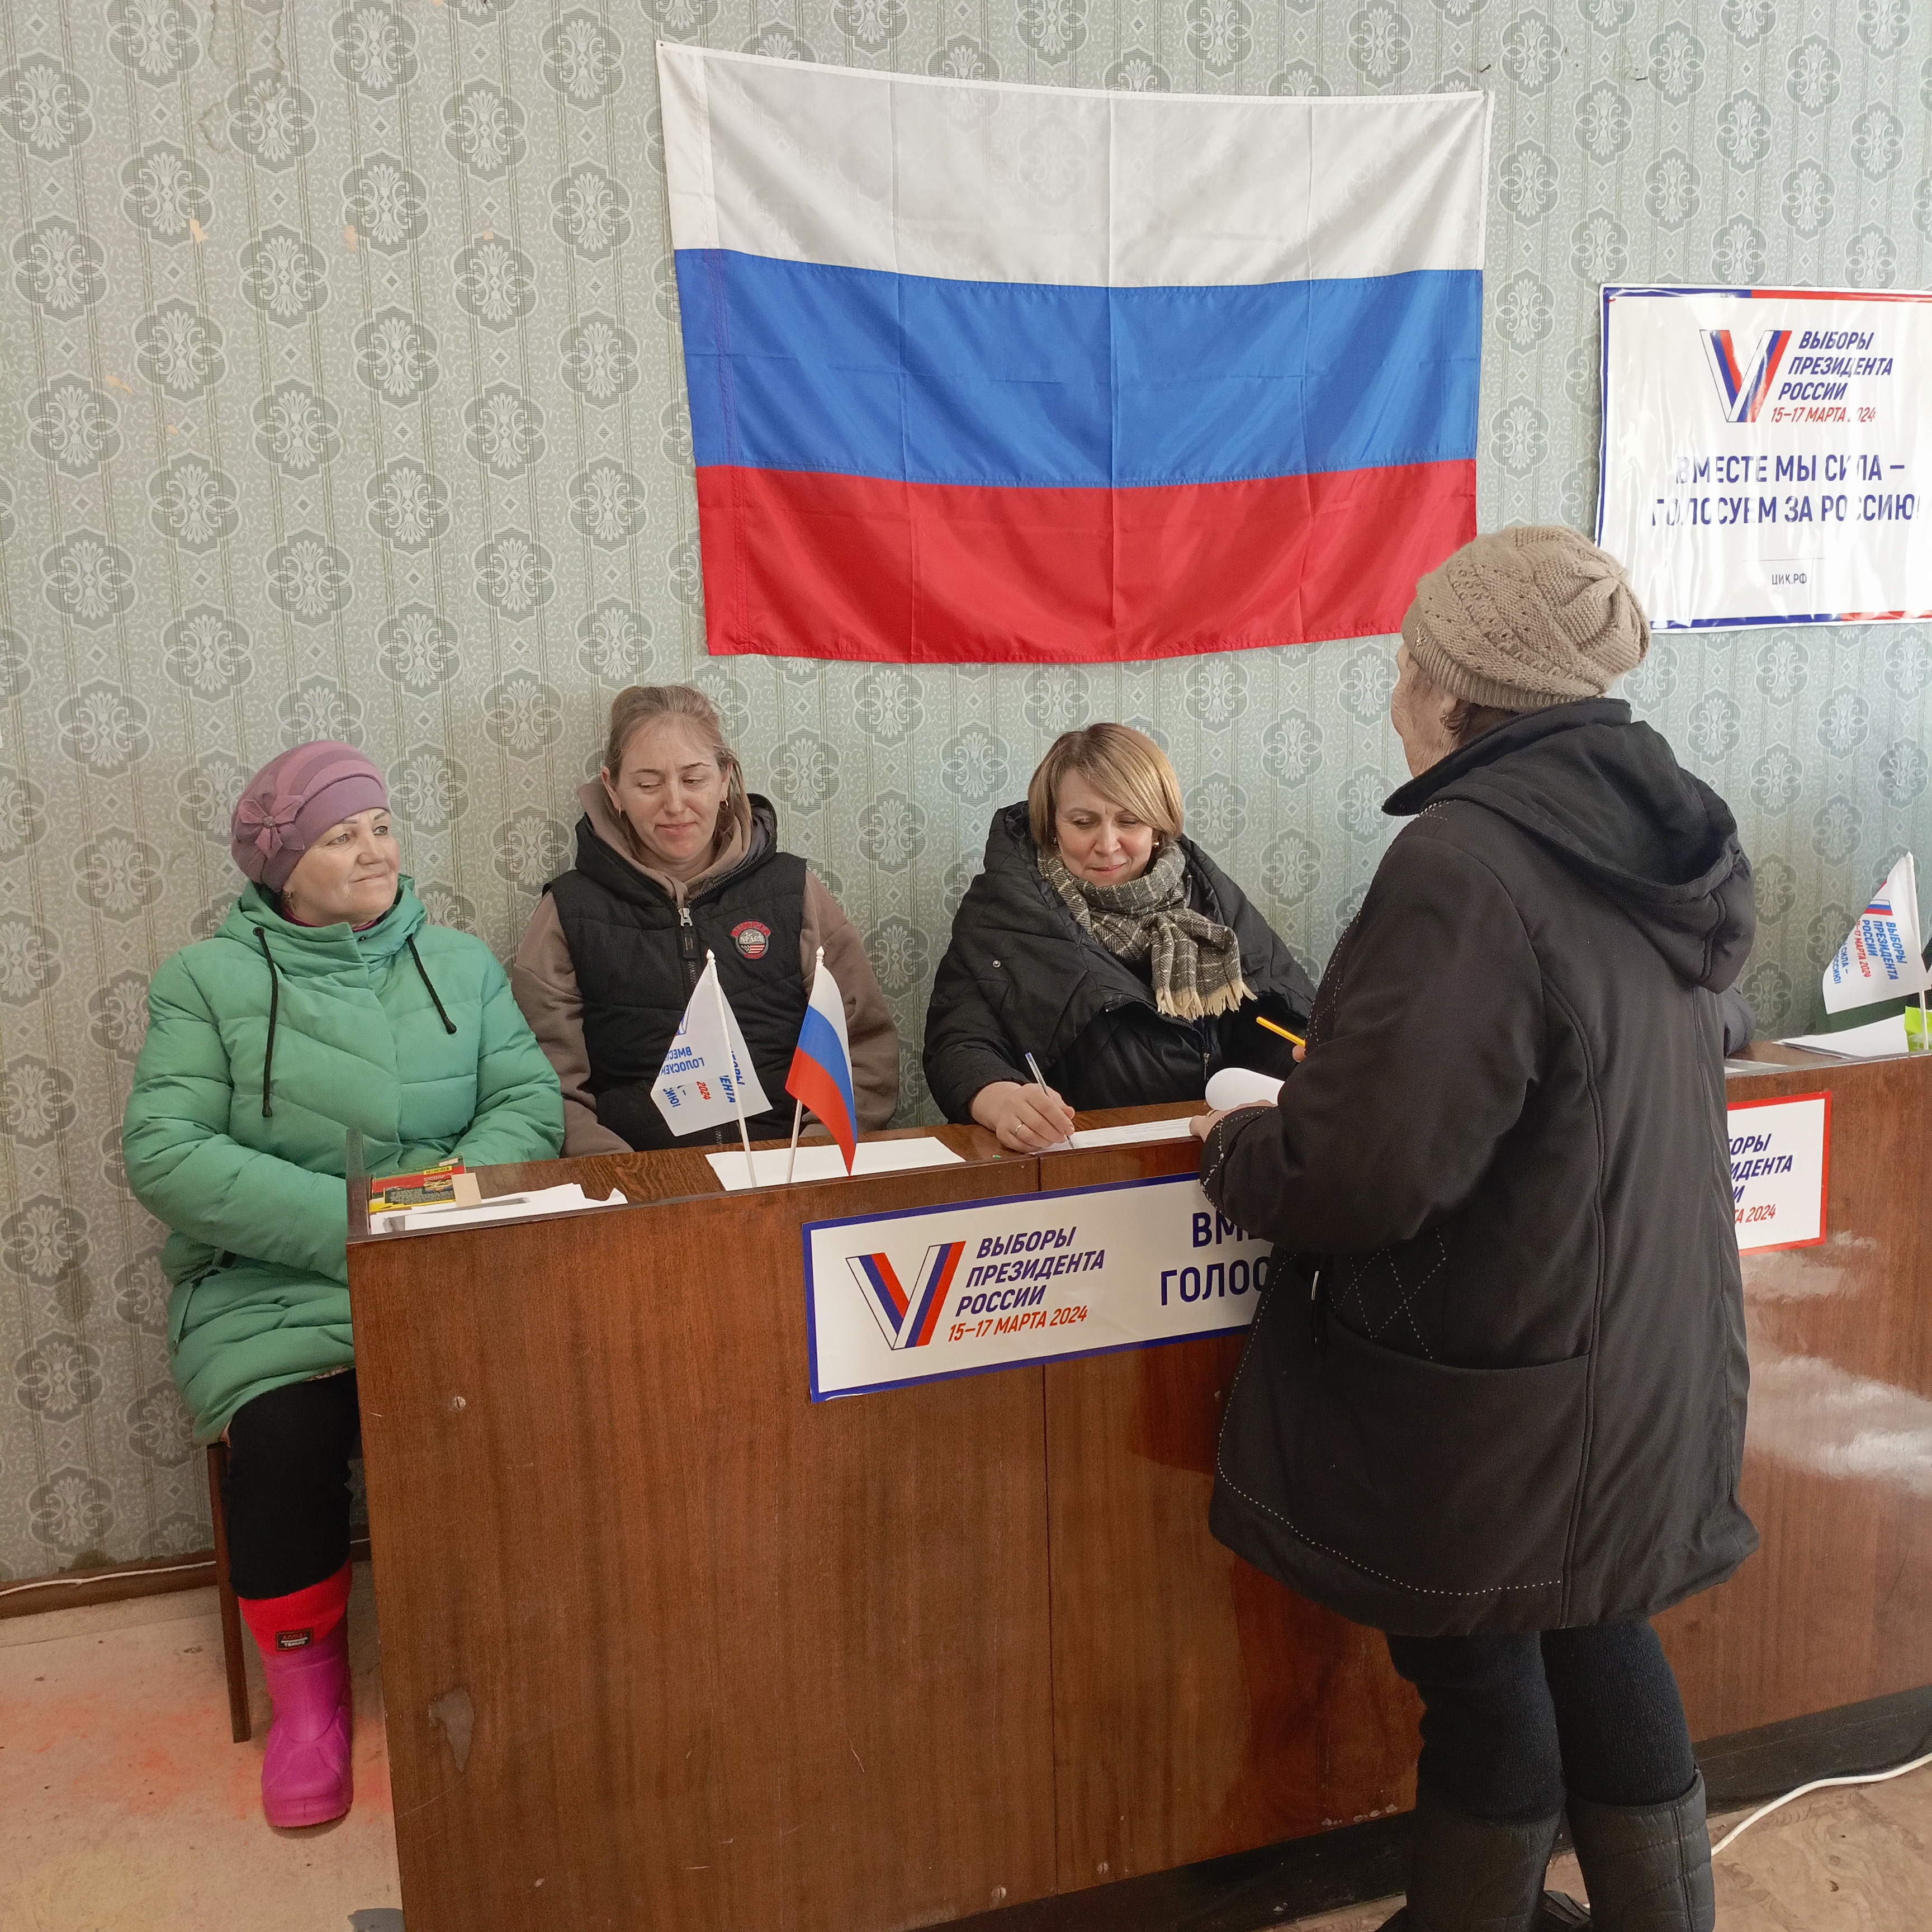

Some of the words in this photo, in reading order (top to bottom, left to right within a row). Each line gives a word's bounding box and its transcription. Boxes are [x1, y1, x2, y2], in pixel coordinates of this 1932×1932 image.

[1798, 331, 1874, 350] ВЫБОРЫ
[1787, 357, 1893, 378] ПРЕЗИДЕНТА
[1778, 382, 1848, 400] РОССИИ
[1805, 407, 1846, 423] МАРТА
[1846, 407, 1877, 423] 024
[1676, 456, 1768, 484] ВМЕСТЕ
[1775, 455, 1817, 482] МЫ
[1825, 454, 1882, 481] СИЛА
[1784, 495, 1813, 523] ЗА
[1821, 494, 1920, 522] РОСИЮ
[1772, 572, 1807, 585] ЦИК.РФ
[1855, 938, 1867, 960] МАРТА
[1862, 920, 1878, 956] РОССИИ
[1873, 920, 1899, 980] ПРЕЗИДЕНТА
[1886, 922, 1908, 964] ВЫБОРЫ
[1859, 962, 1872, 977] 2024
[697, 1081, 712, 1100] 2024
[1745, 1204, 1777, 1223] 2024
[976, 1226, 1077, 1259] ВЫБОРЫ
[965, 1249, 1106, 1288] ПРЕЗИДЕНТА
[955, 1284, 1047, 1317] РОССИИ
[993, 1310, 1048, 1336] МАРТА
[1049, 1305, 1087, 1327] 2024
